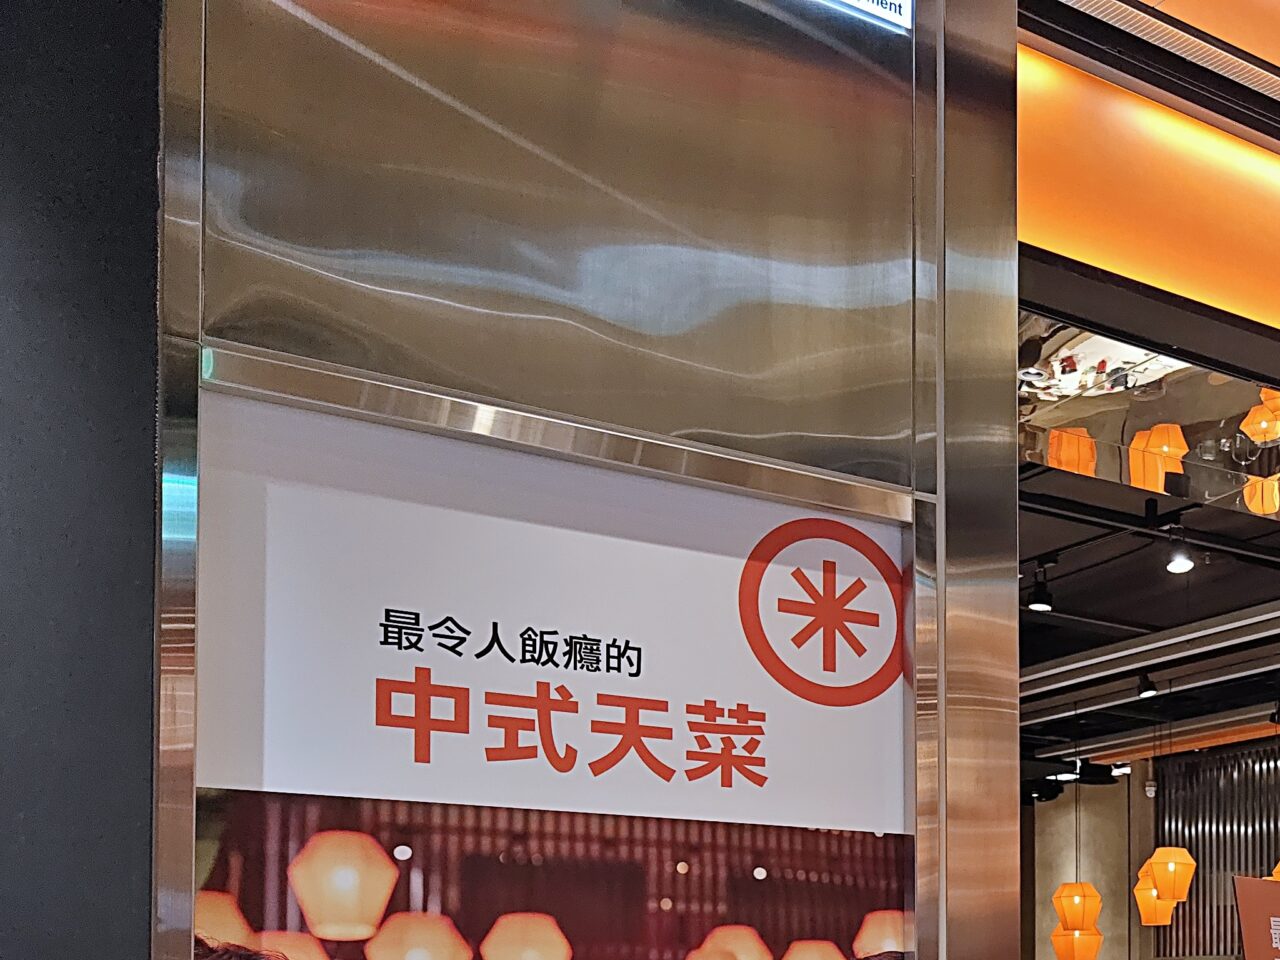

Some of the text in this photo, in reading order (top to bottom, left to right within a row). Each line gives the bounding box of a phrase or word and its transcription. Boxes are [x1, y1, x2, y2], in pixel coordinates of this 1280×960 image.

[379, 608, 643, 677] 最令人飯癮的
[374, 666, 769, 788] 中式天菜
